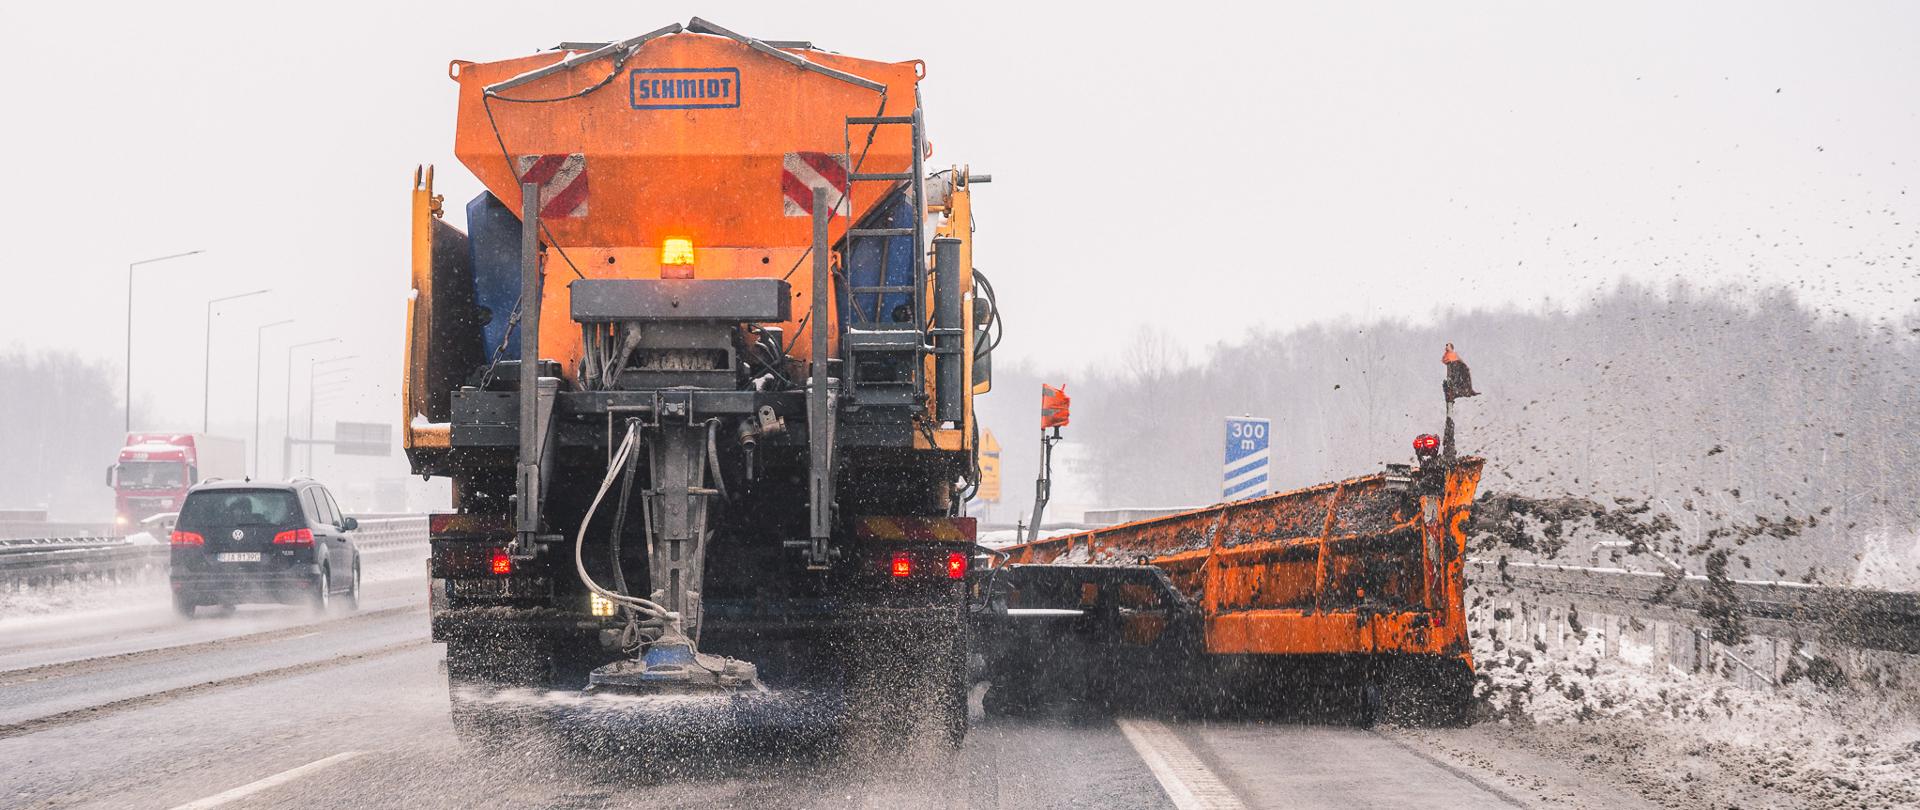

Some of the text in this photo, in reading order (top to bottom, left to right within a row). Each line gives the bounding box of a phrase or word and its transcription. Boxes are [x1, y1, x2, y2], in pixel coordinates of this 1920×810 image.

[639, 78, 731, 98] SCHMIDT
[1232, 423, 1265, 438] 300
[1241, 439, 1255, 450] m
